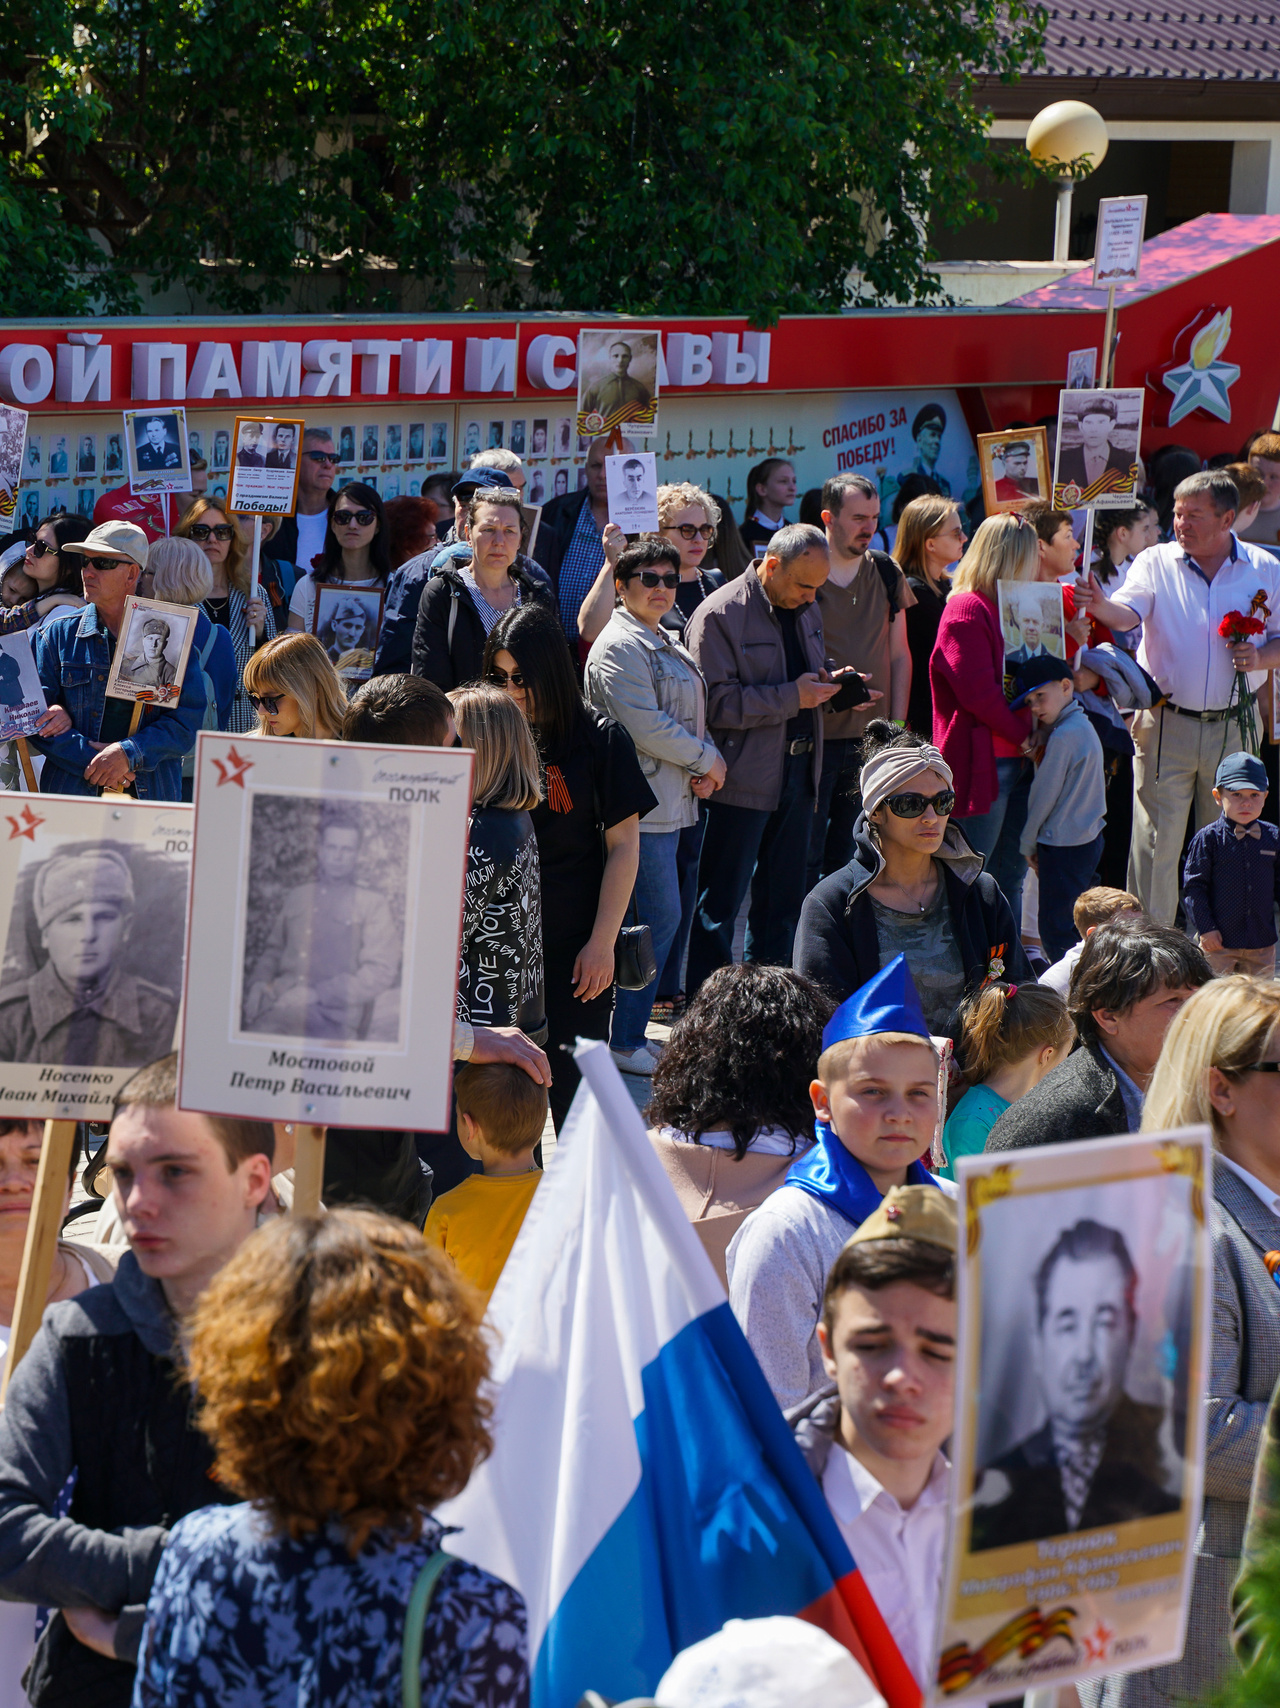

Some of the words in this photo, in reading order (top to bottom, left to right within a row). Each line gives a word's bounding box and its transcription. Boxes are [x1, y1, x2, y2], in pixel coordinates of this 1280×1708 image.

[131, 339, 452, 400] ПАМЯТИ
[464, 337, 516, 393] И
[526, 331, 771, 390] СВЫ
[822, 413, 886, 448] СПАСИБО
[889, 406, 907, 429] ЗА
[837, 437, 895, 471] ПОБЕДУ!
[234, 500, 288, 513] Победы!
[9, 707, 40, 721] Николай
[389, 787, 440, 804] ПОЛК
[474, 953, 500, 1015] LOVE
[269, 1051, 376, 1074] Мостовой
[38, 1068, 114, 1084] Носенко
[230, 1071, 286, 1096] Петр
[291, 1077, 411, 1100] Васильевич
